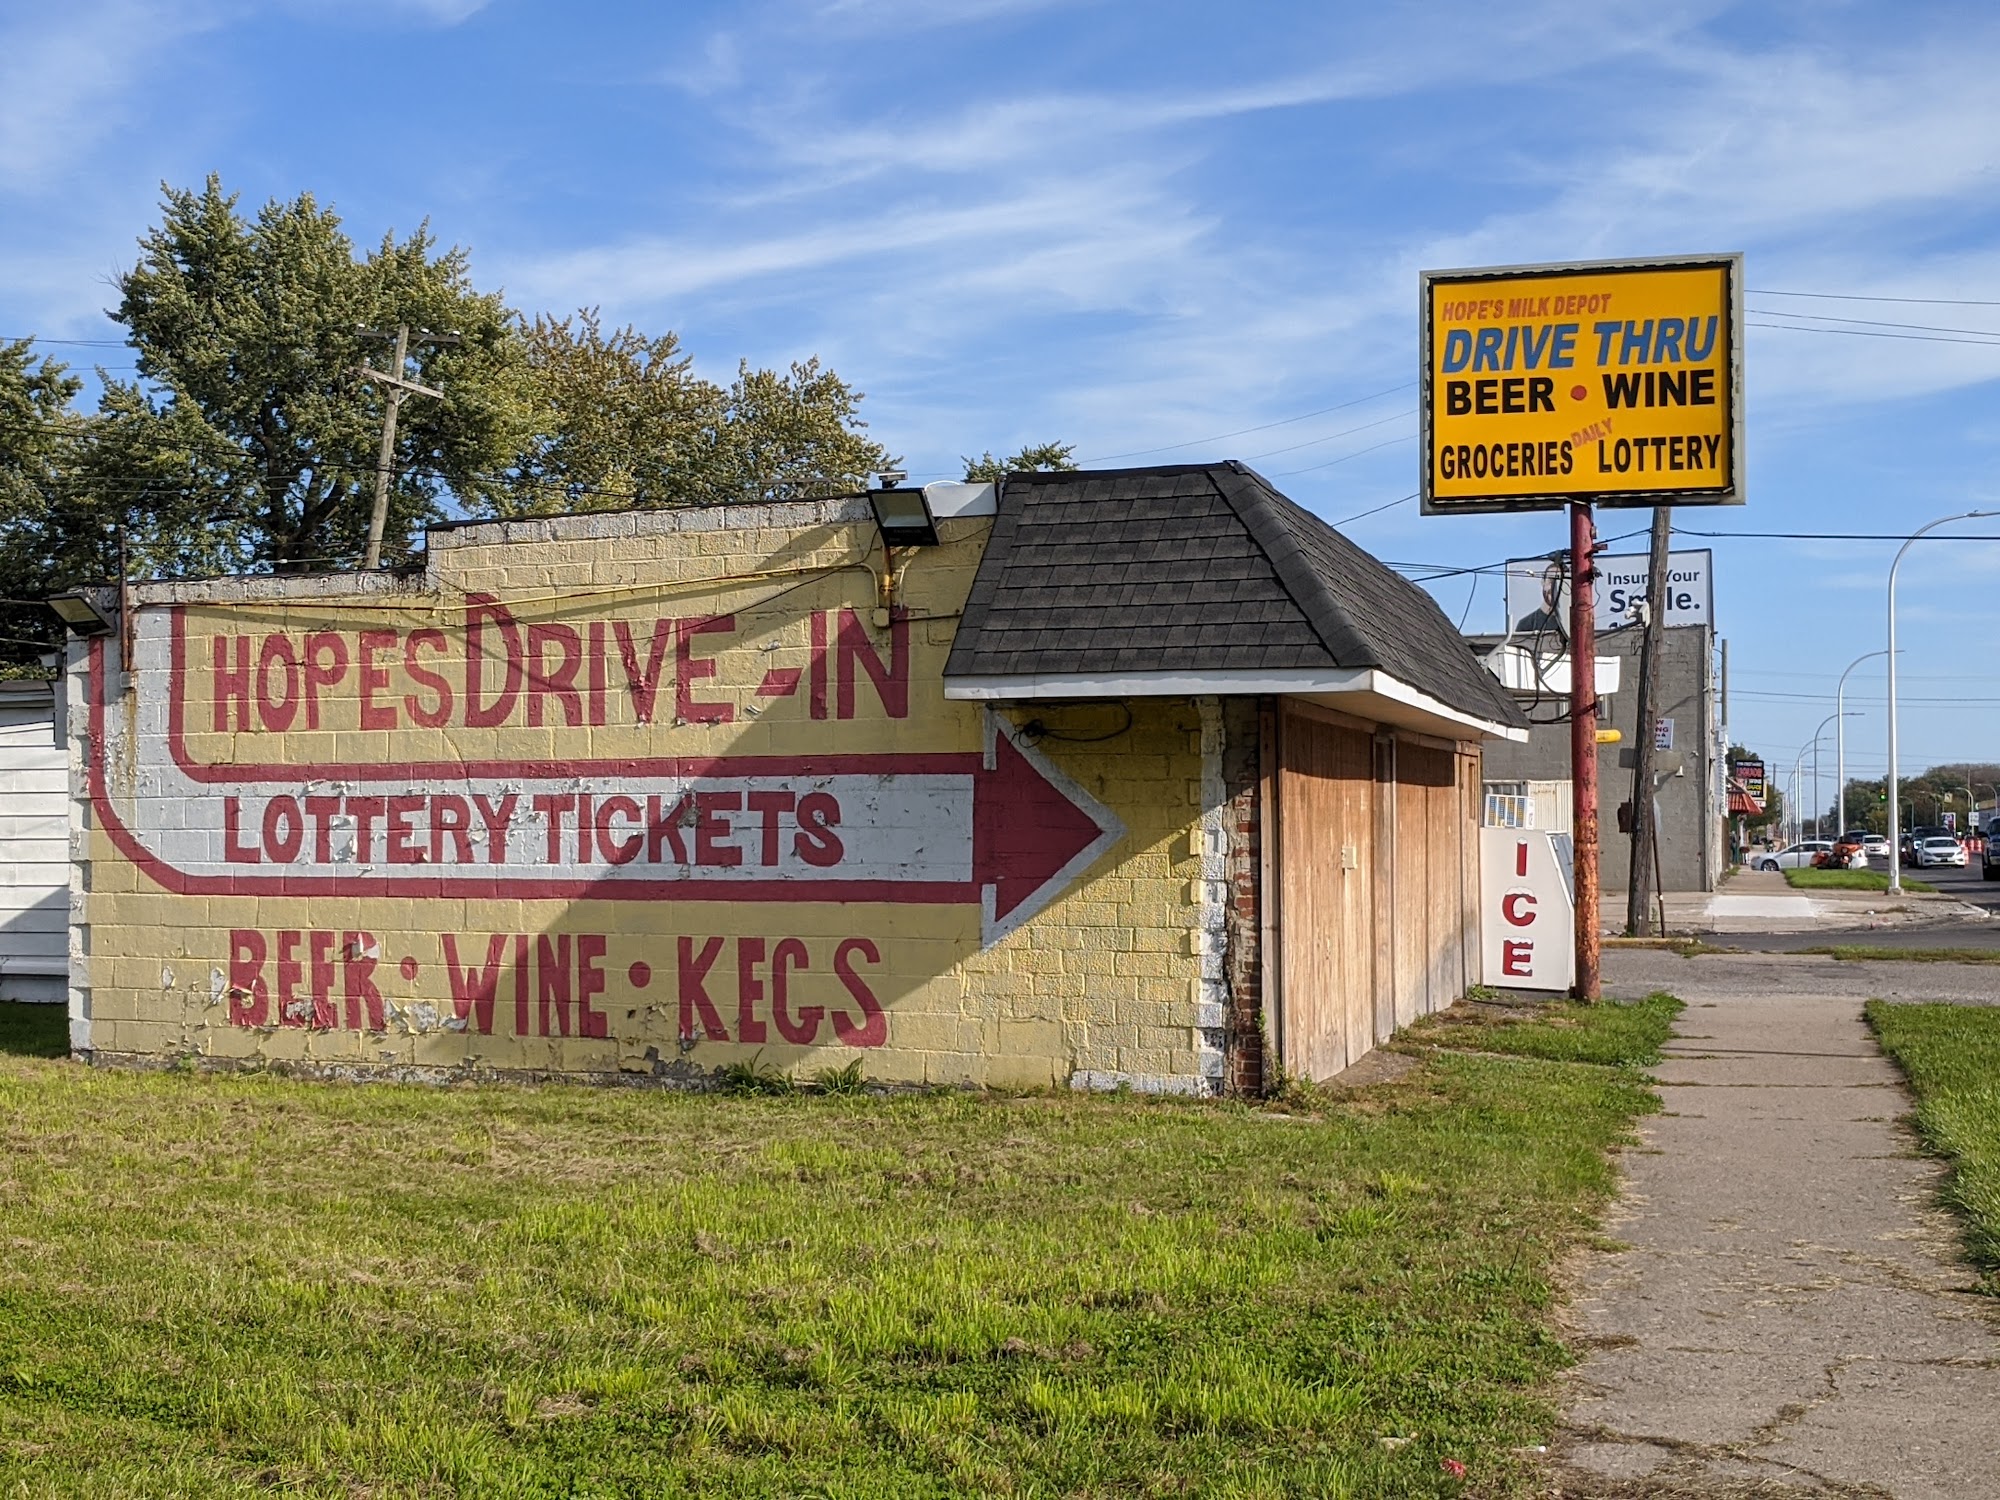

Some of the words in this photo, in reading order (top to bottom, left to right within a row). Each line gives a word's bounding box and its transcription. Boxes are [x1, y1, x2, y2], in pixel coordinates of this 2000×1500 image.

[1442, 299, 1504, 321] HOPE'S
[1507, 296, 1550, 318] MILK
[1553, 293, 1612, 316] DEPOT
[1441, 323, 1580, 373] DRIVE
[1594, 315, 1718, 367] THRU
[1446, 376, 1556, 416] BEER
[1602, 369, 1715, 409] WINE
[1571, 417, 1613, 448] DAILY
[1440, 440, 1573, 480] GROCERIES
[1598, 434, 1721, 473] LOTTERY
[1607, 572, 1649, 585] Insur
[1609, 586, 1700, 613] Sle.
[213, 628, 454, 732] HOPES
[223, 793, 518, 865] LOTTERY
[528, 791, 844, 867] TICKETS
[1502, 837, 1538, 977] ICE
[229, 929, 386, 1031] BEER
[440, 933, 608, 1038] WINE
[677, 936, 887, 1048] KEGS
